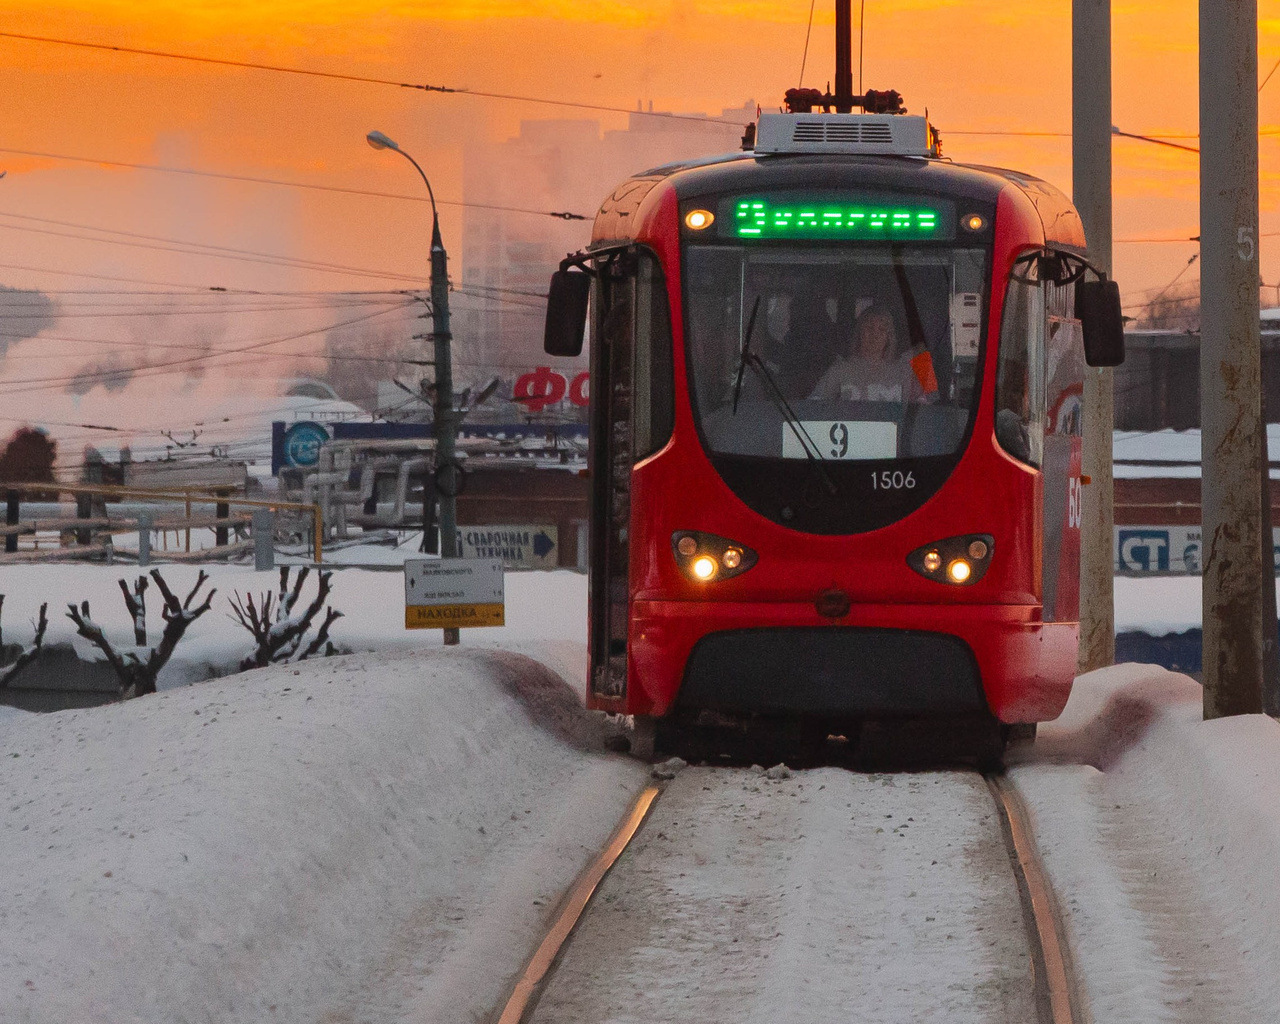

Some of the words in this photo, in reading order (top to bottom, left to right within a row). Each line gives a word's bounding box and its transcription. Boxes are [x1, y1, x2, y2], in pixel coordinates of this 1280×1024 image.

[1237, 227, 1254, 260] 5
[829, 422, 850, 458] 9
[871, 470, 916, 490] 1506
[417, 607, 477, 619] НАХОДКА
